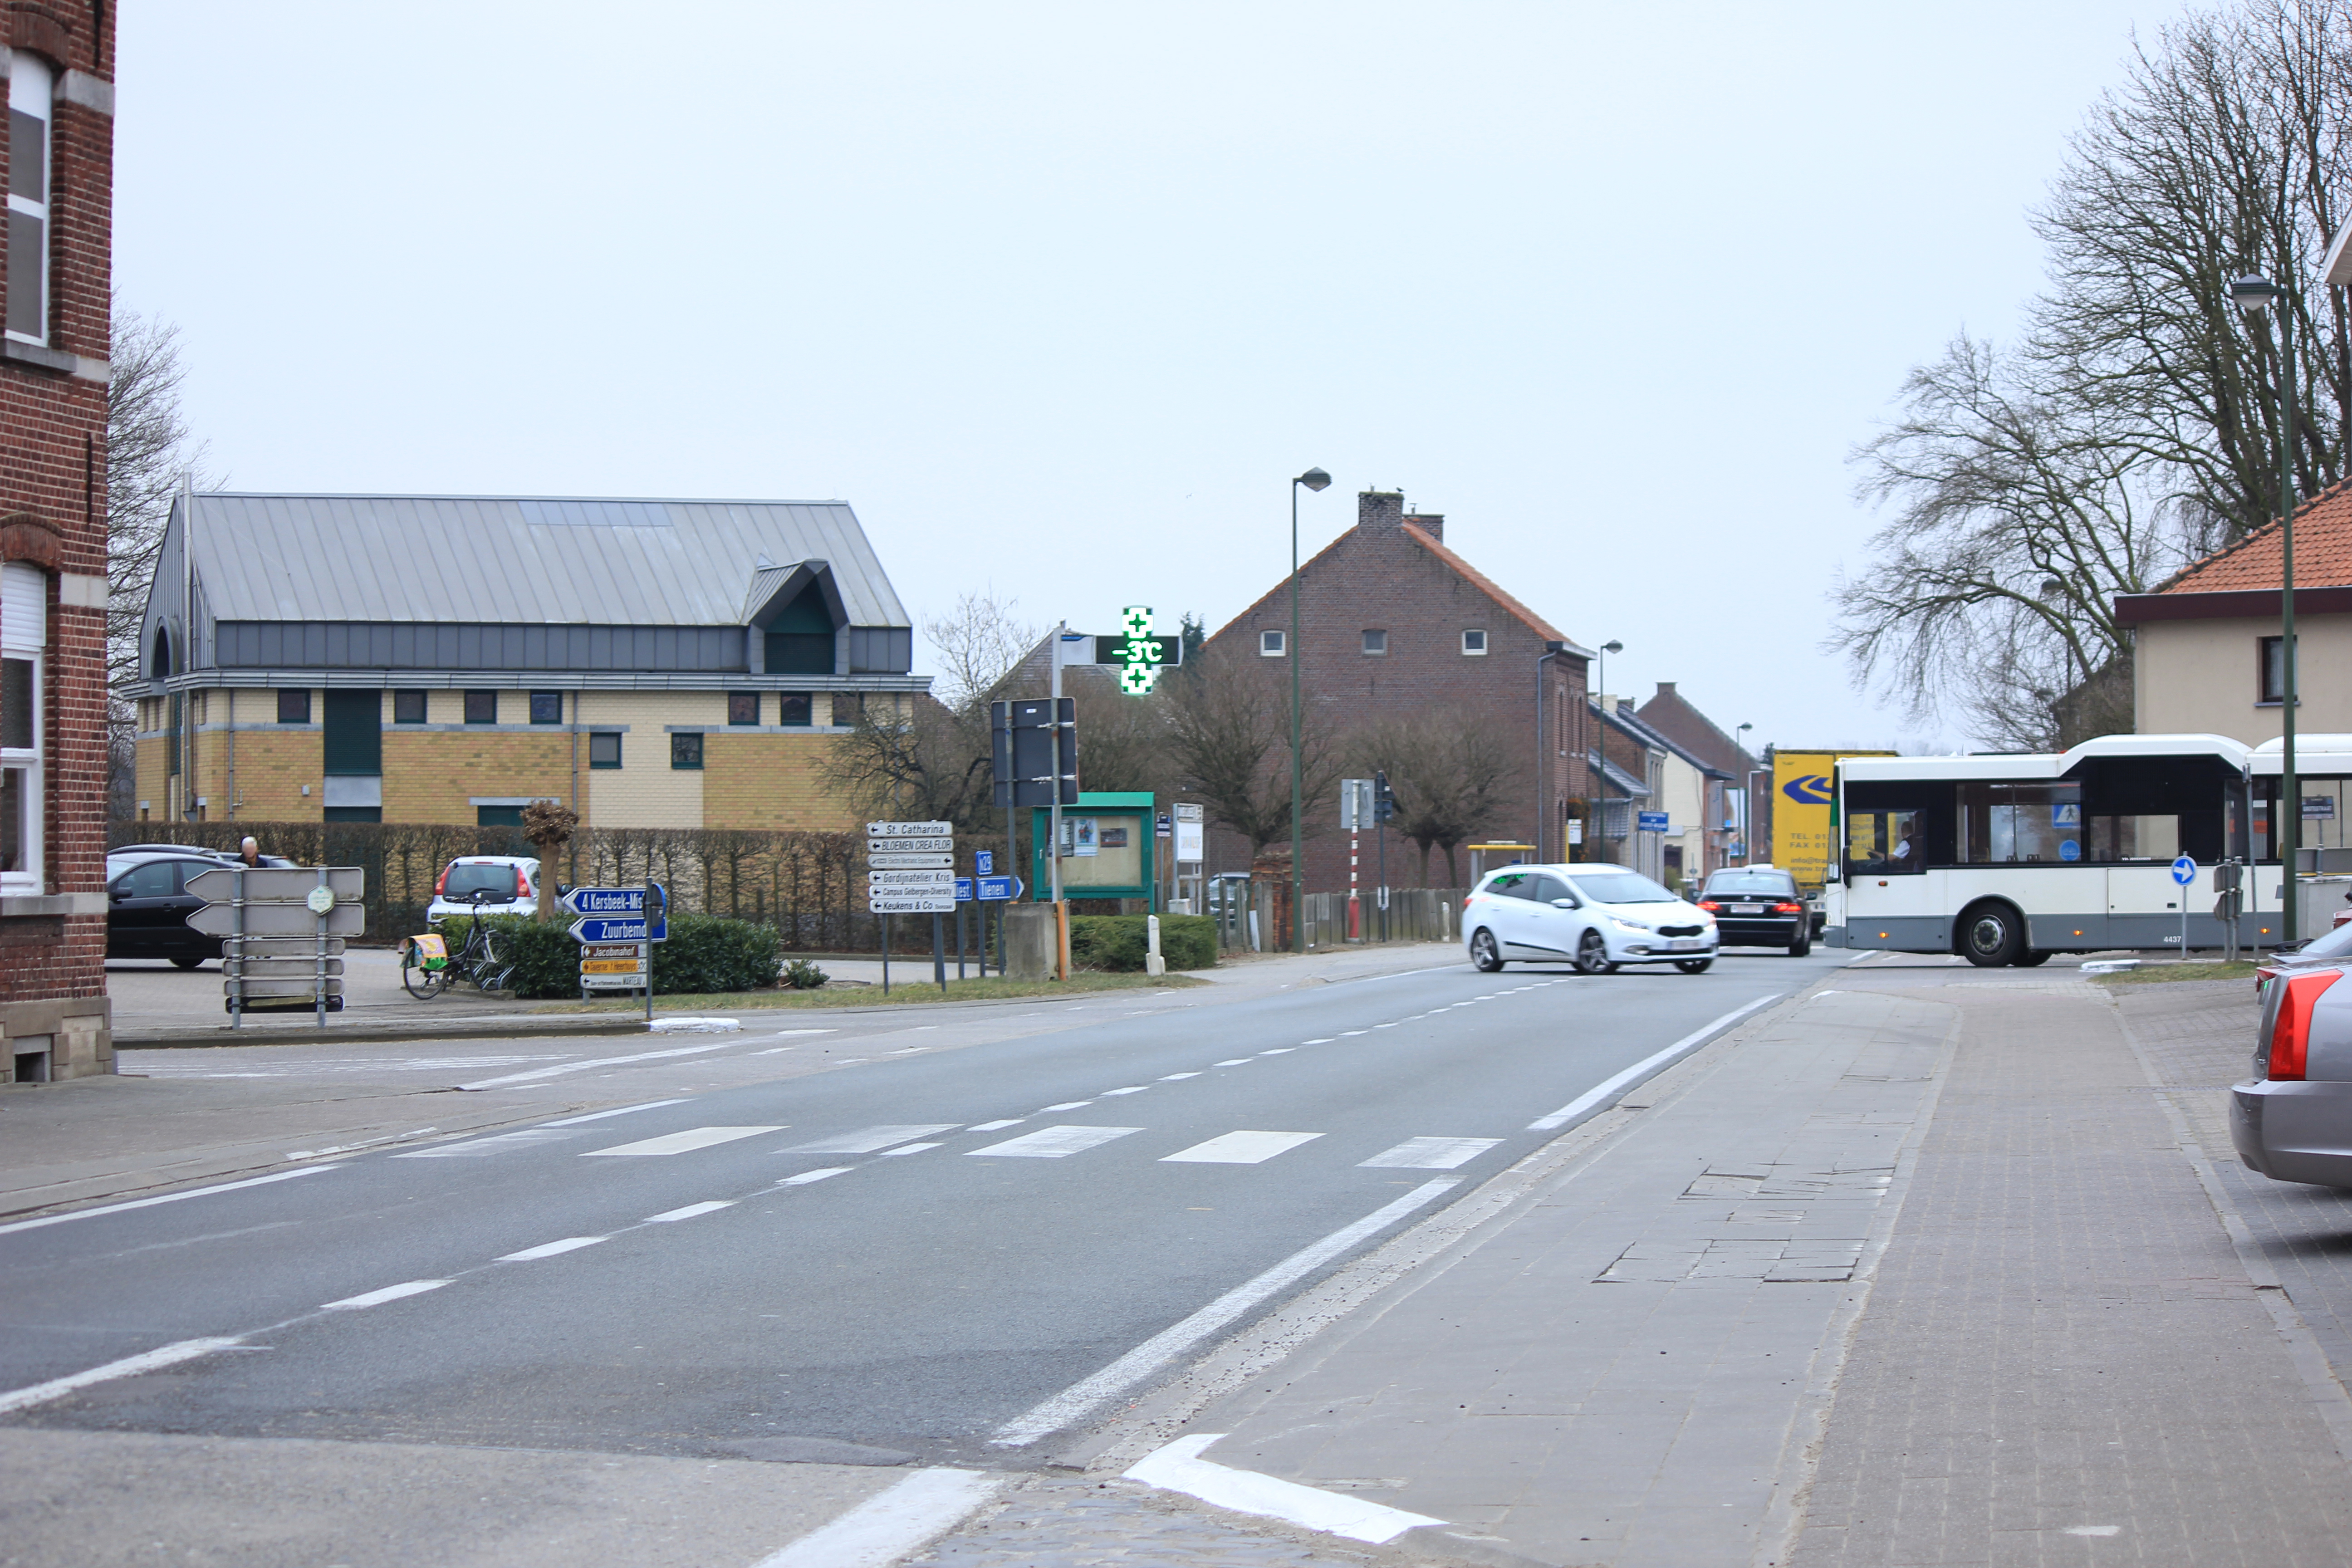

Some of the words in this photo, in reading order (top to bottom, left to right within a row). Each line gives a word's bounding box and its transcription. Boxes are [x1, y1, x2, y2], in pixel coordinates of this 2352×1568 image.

[886, 825, 898, 834] St.
[901, 824, 944, 834] Catharina
[882, 841, 913, 851] BLOEMEN
[915, 840, 932, 850] CREA
[933, 839, 951, 849] FLOR
[980, 855, 991, 871] N29
[884, 873, 932, 884] Gordijnatelier
[935, 872, 950, 882] Kris
[883, 888, 903, 897] Campus
[956, 882, 970, 898] iest
[980, 881, 1005, 897] Tienen
[582, 893, 589, 910] 4
[590, 892, 645, 910] Kersbeek-Mis
[883, 902, 913, 911] Keukens
[915, 901, 920, 910] &
[923, 901, 933, 909] Co
[601, 921, 647, 939] Zuurbemd
[593, 946, 635, 957] Jacobinahof
[590, 961, 608, 971] Taverne
